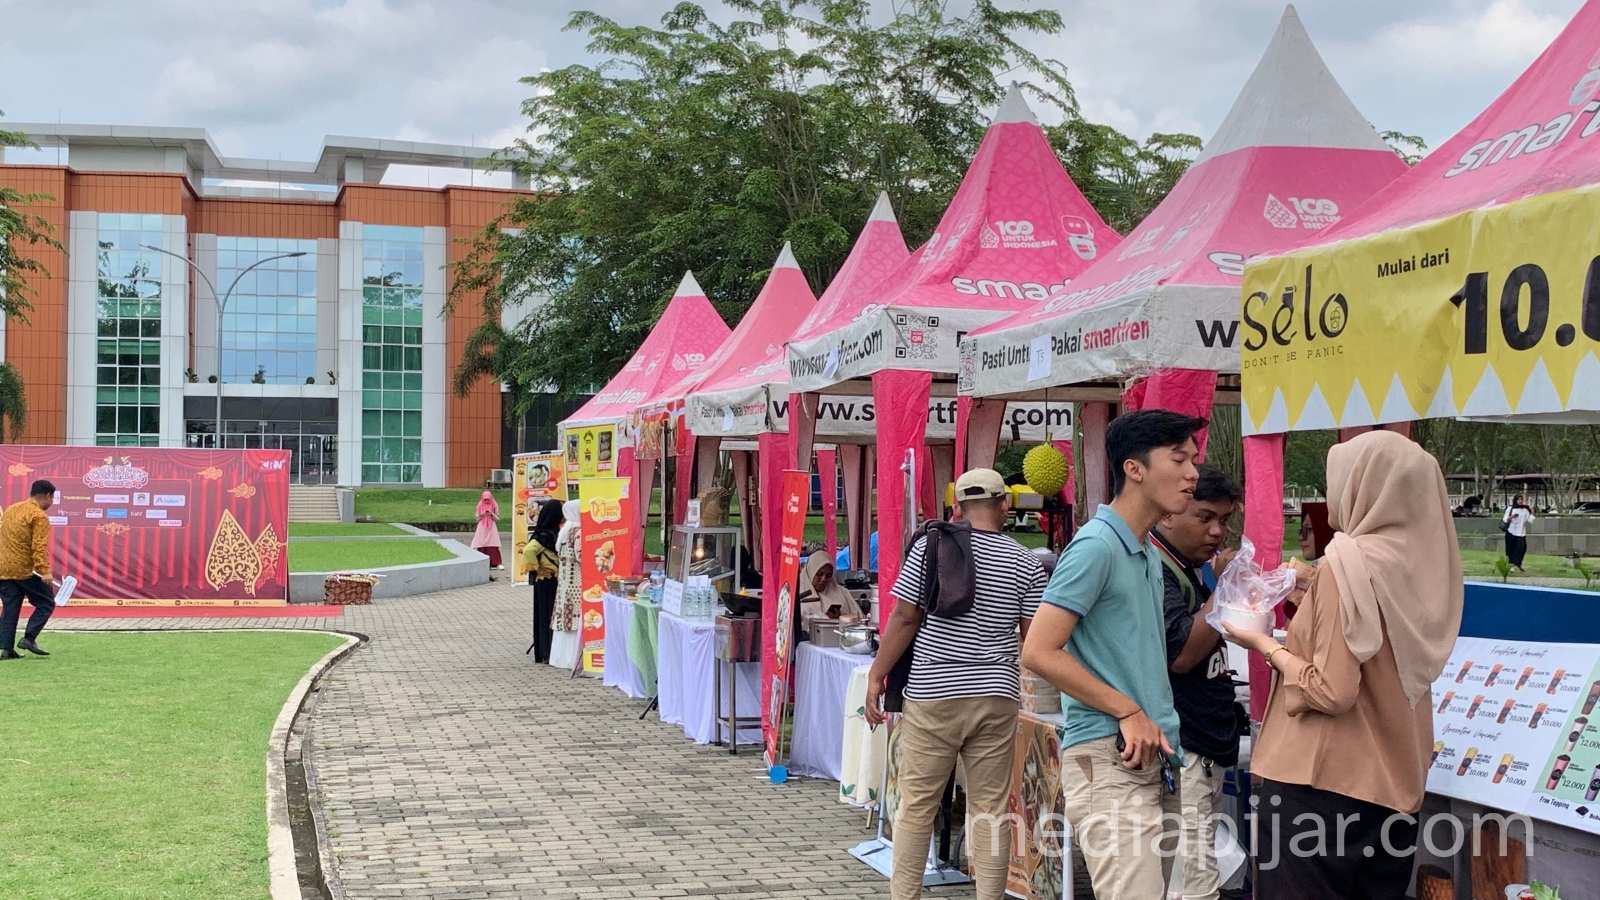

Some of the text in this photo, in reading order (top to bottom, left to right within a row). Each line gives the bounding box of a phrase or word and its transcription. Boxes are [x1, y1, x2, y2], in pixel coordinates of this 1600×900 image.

[1003, 240, 1058, 248] INDONESIA
[1377, 248, 1450, 278] Mulai dari
[982, 345, 1005, 371] Pasti
[1084, 317, 1149, 350] smartfren
[1244, 344, 1344, 370] DON'T BE PANIC
[1497, 678, 1516, 686] 10.000
[1528, 681, 1547, 690] 10.000
[1560, 684, 1581, 693] 10.000
[1449, 705, 1467, 714] 10.000
[1478, 710, 1497, 719] 10.000
[1509, 714, 1529, 724] 10.000
[1542, 719, 1563, 728] 10.000
[1435, 762, 1454, 771] 10.000
[1469, 769, 1489, 778] 10.000
[1505, 776, 1527, 786] 10.000
[1562, 780, 1586, 791] 12.000
